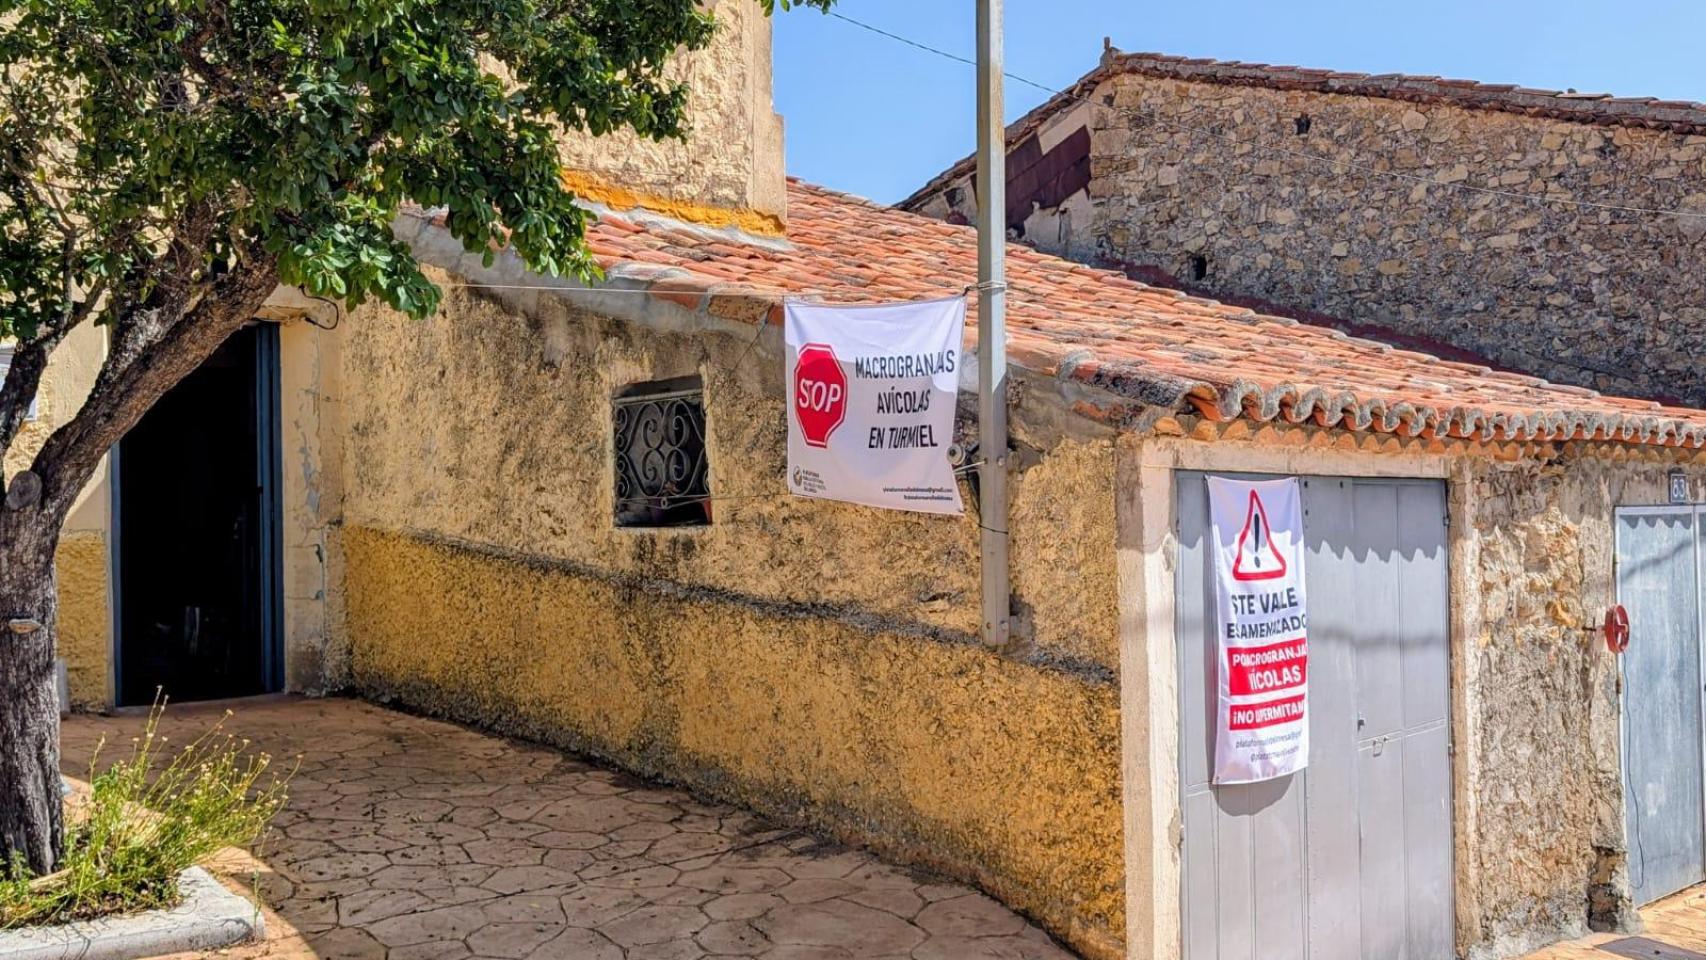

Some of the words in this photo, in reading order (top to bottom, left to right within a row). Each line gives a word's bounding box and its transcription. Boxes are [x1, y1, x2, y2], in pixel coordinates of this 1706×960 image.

[799, 378, 841, 412] STOP
[877, 386, 931, 414] AVÍCOLAS
[868, 427, 886, 449] EN
[888, 424, 938, 449] TURMIEL
